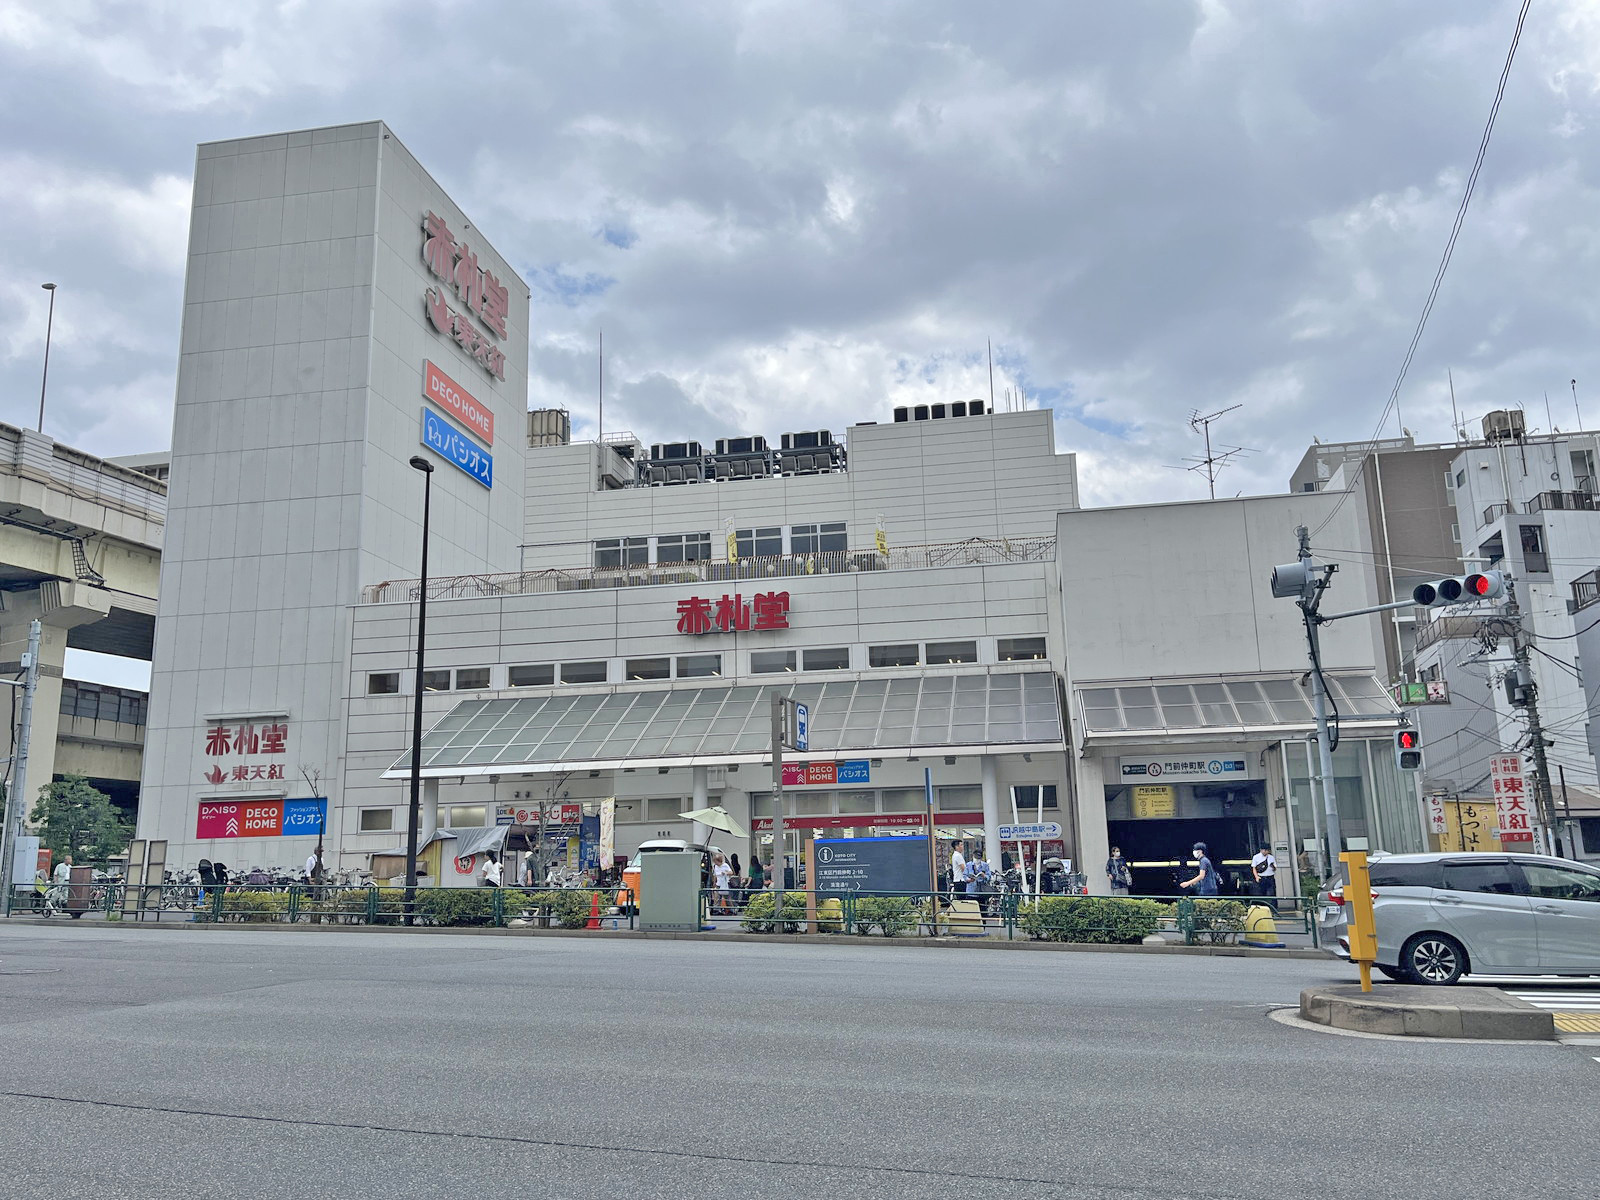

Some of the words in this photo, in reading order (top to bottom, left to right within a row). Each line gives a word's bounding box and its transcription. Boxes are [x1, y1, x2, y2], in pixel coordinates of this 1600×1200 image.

[422, 209, 508, 341] 赤札堂
[453, 311, 506, 382] 東天紅
[431, 375, 460, 410] DECO
[461, 399, 489, 433] HOME
[443, 434, 490, 482] パシオス
[677, 591, 790, 634] 赤札堂
[206, 724, 288, 756] 赤札堂
[231, 764, 285, 781] 東天紅
[839, 769, 868, 778] パシオス
[1164, 762, 1205, 770] 門前仲町駅
[202, 806, 237, 815] DAISO
[246, 808, 278, 818] DECO
[530, 806, 560, 820] 宝くじ
[1493, 778, 1507, 830] 東天紅
[1502, 777, 1530, 829] 東天紅
[245, 819, 277, 829] HOME
